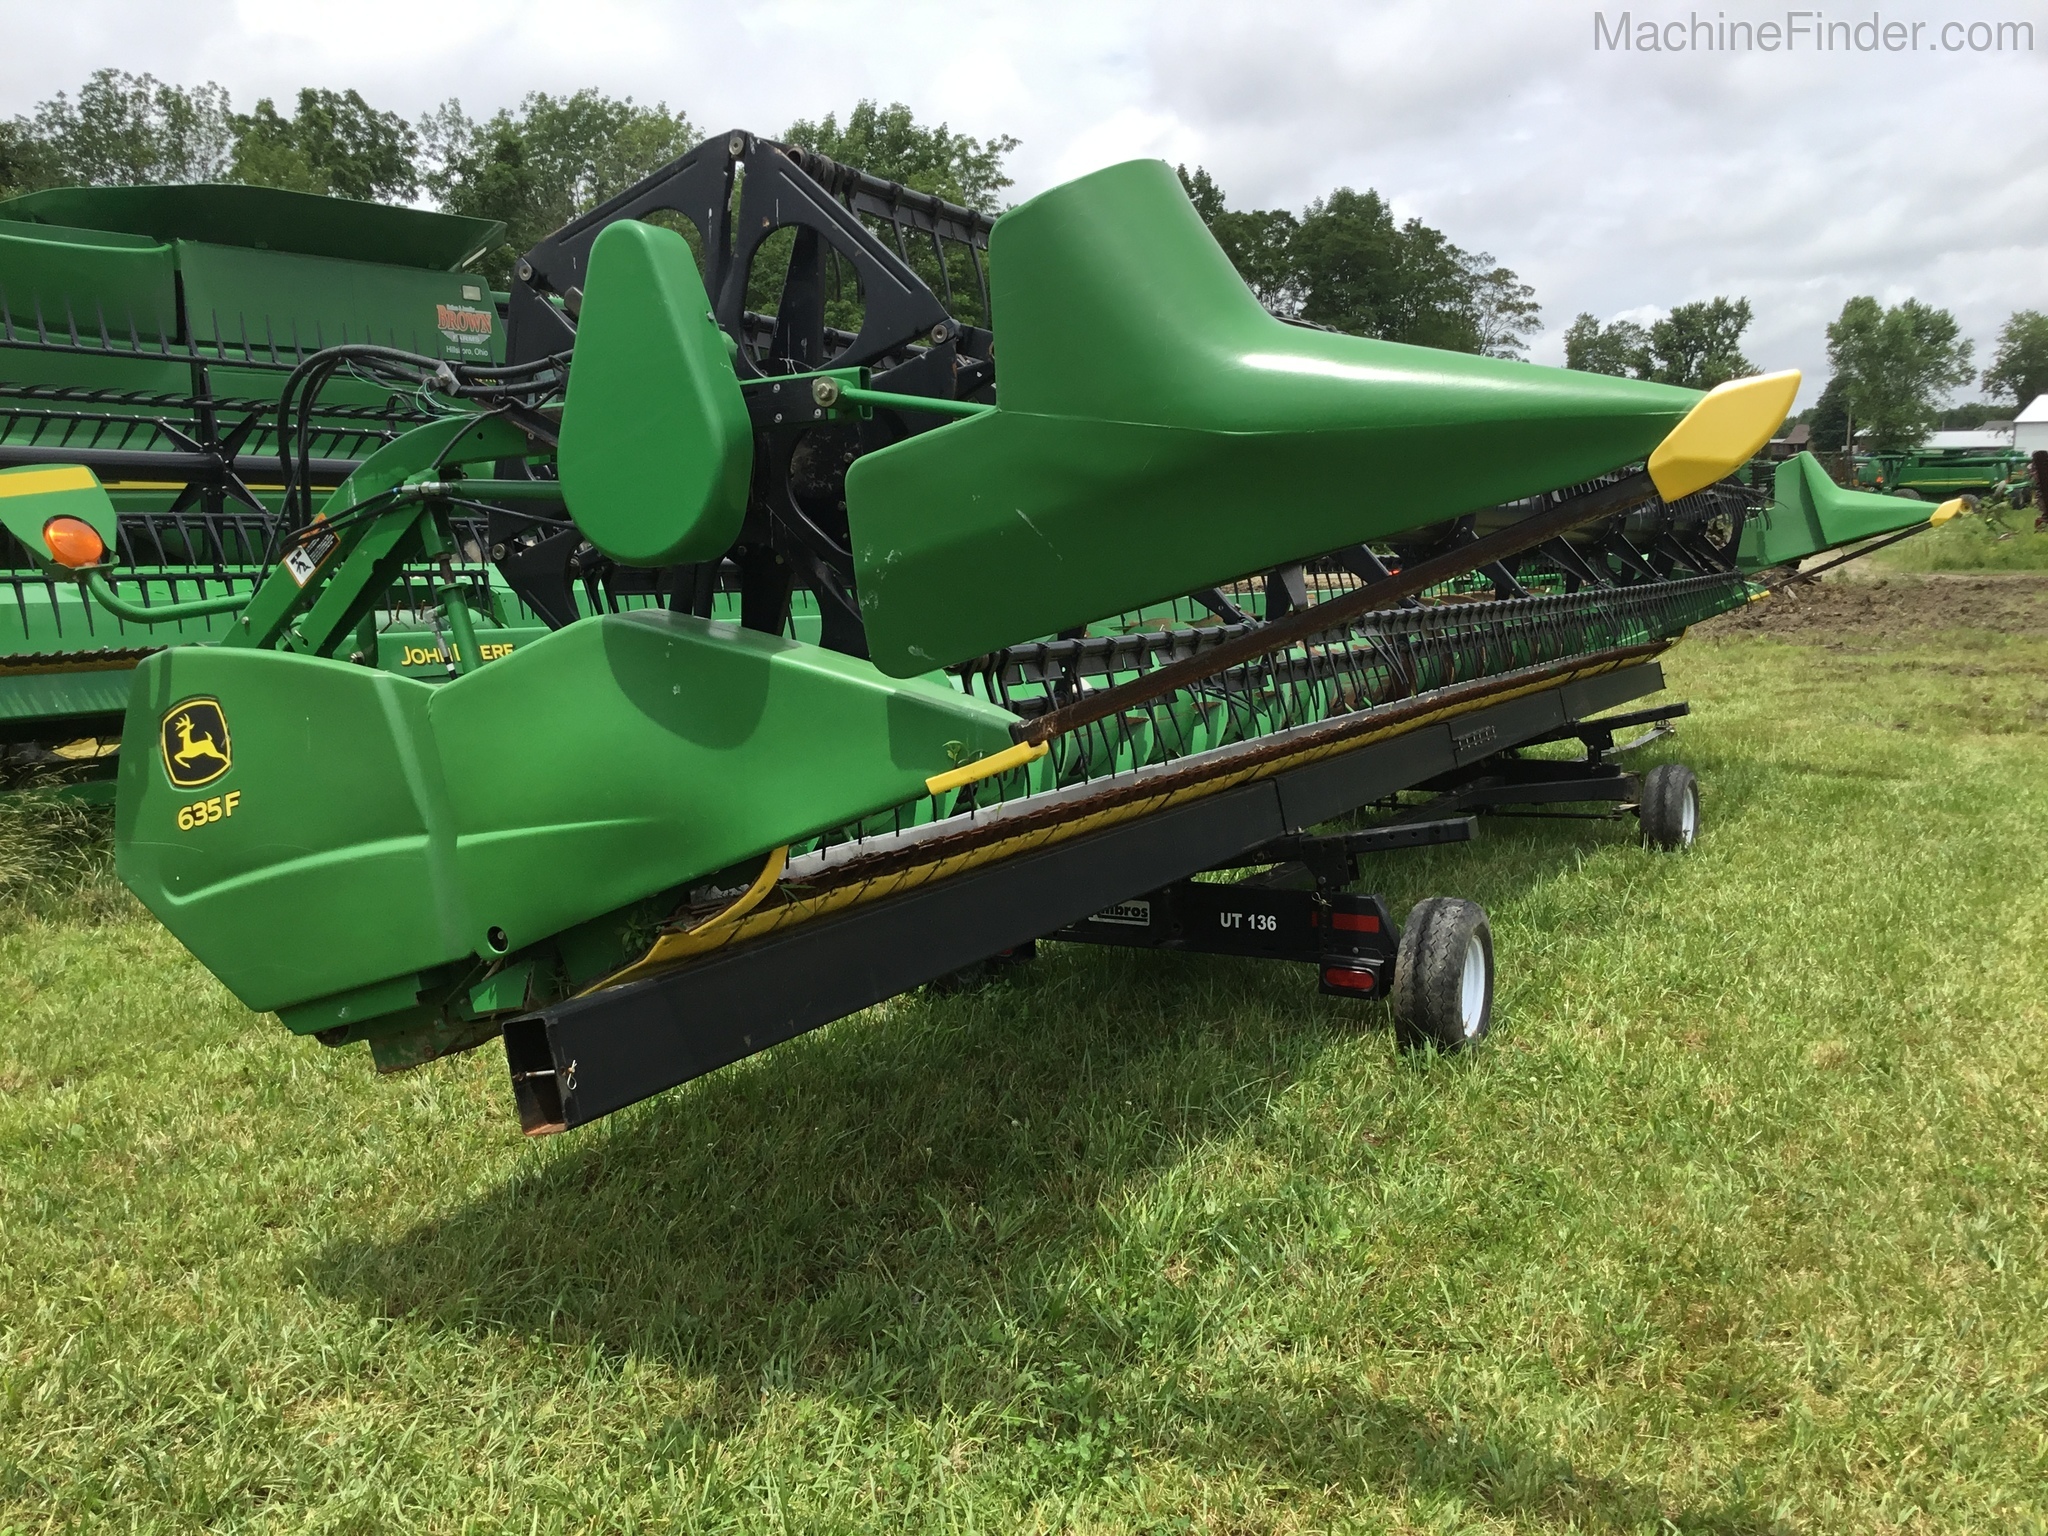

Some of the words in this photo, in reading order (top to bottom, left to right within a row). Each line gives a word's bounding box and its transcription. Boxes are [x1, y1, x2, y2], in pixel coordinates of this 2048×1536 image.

[436, 304, 492, 334] BROWN
[474, 347, 489, 356] Ohio
[1220, 912, 1243, 928] UT
[1247, 913, 1277, 931] 136
